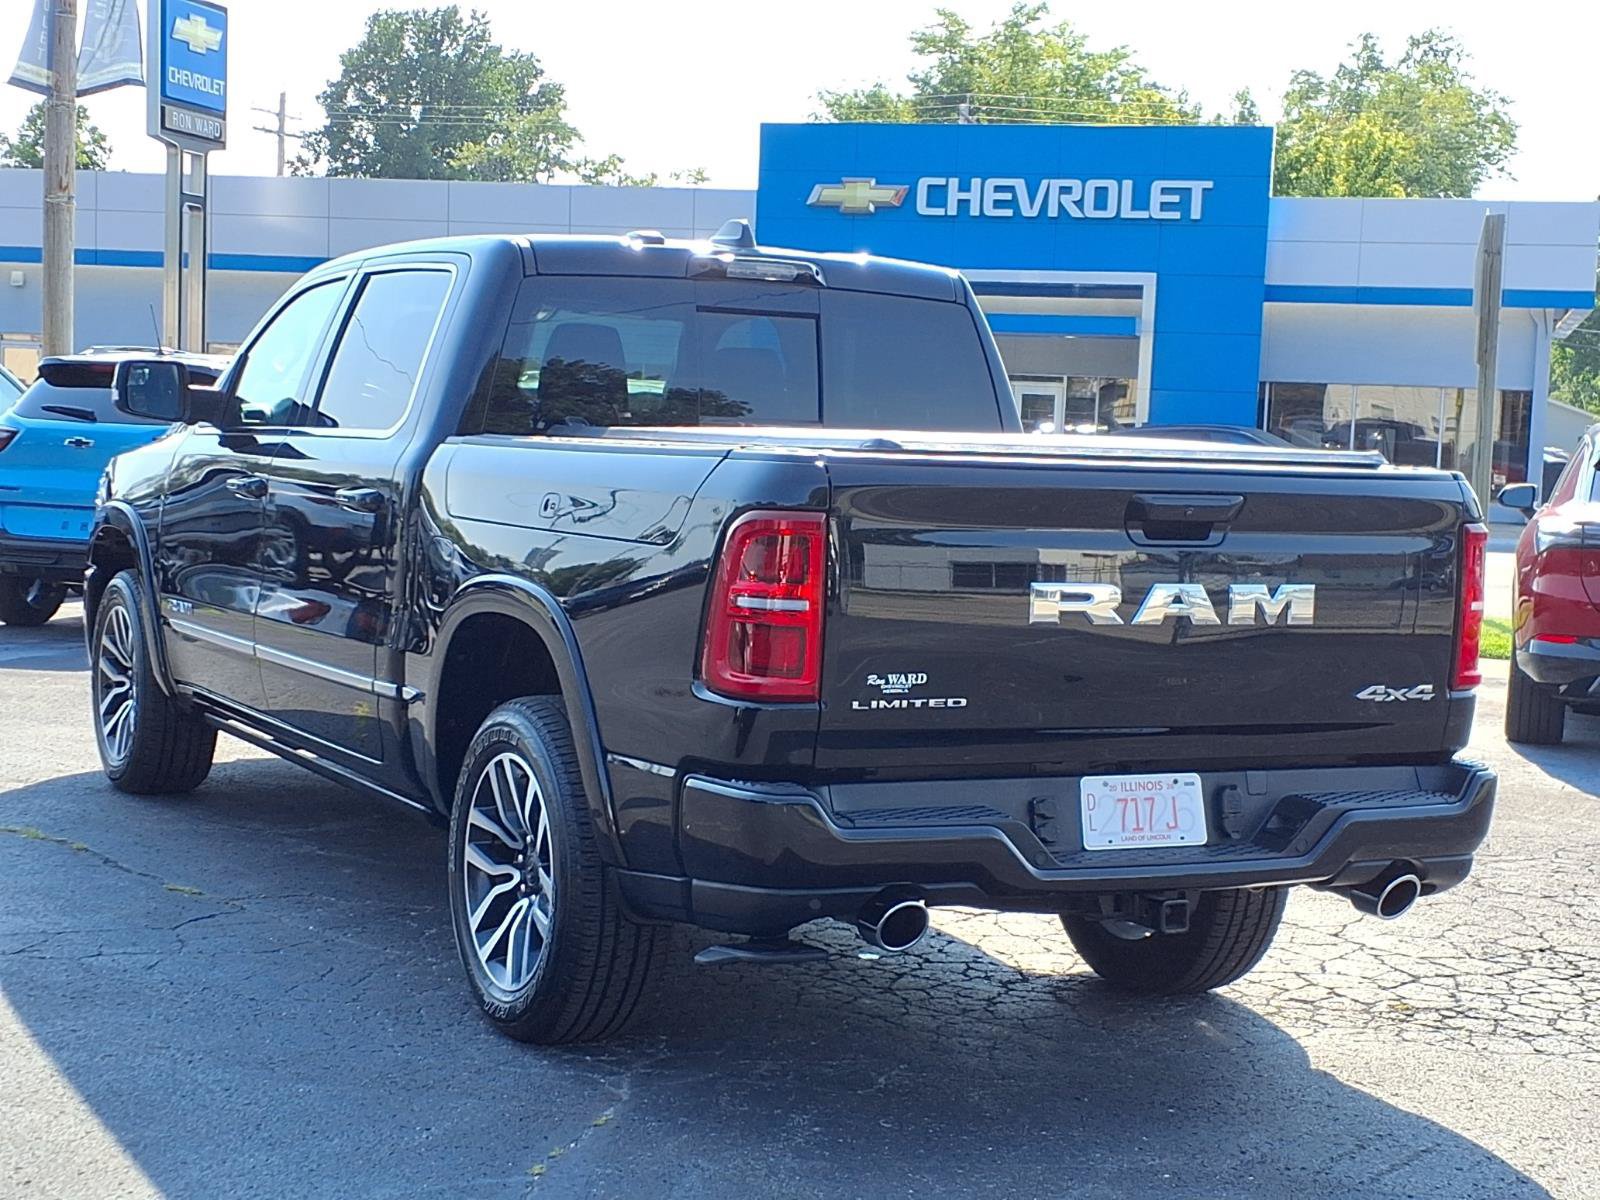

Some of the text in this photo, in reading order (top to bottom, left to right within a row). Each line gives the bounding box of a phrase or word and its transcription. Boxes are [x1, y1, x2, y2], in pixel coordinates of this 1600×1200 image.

[168, 66, 225, 96] CHEVROLET
[172, 111, 221, 138] RON WARD
[915, 176, 1214, 220] CHEVROLET
[1028, 582, 1317, 626] RAM
[887, 672, 928, 685] WARD
[851, 698, 968, 710] LIMITED
[1356, 684, 1436, 702] 4x4
[1120, 780, 1164, 792] ILLINOIS
